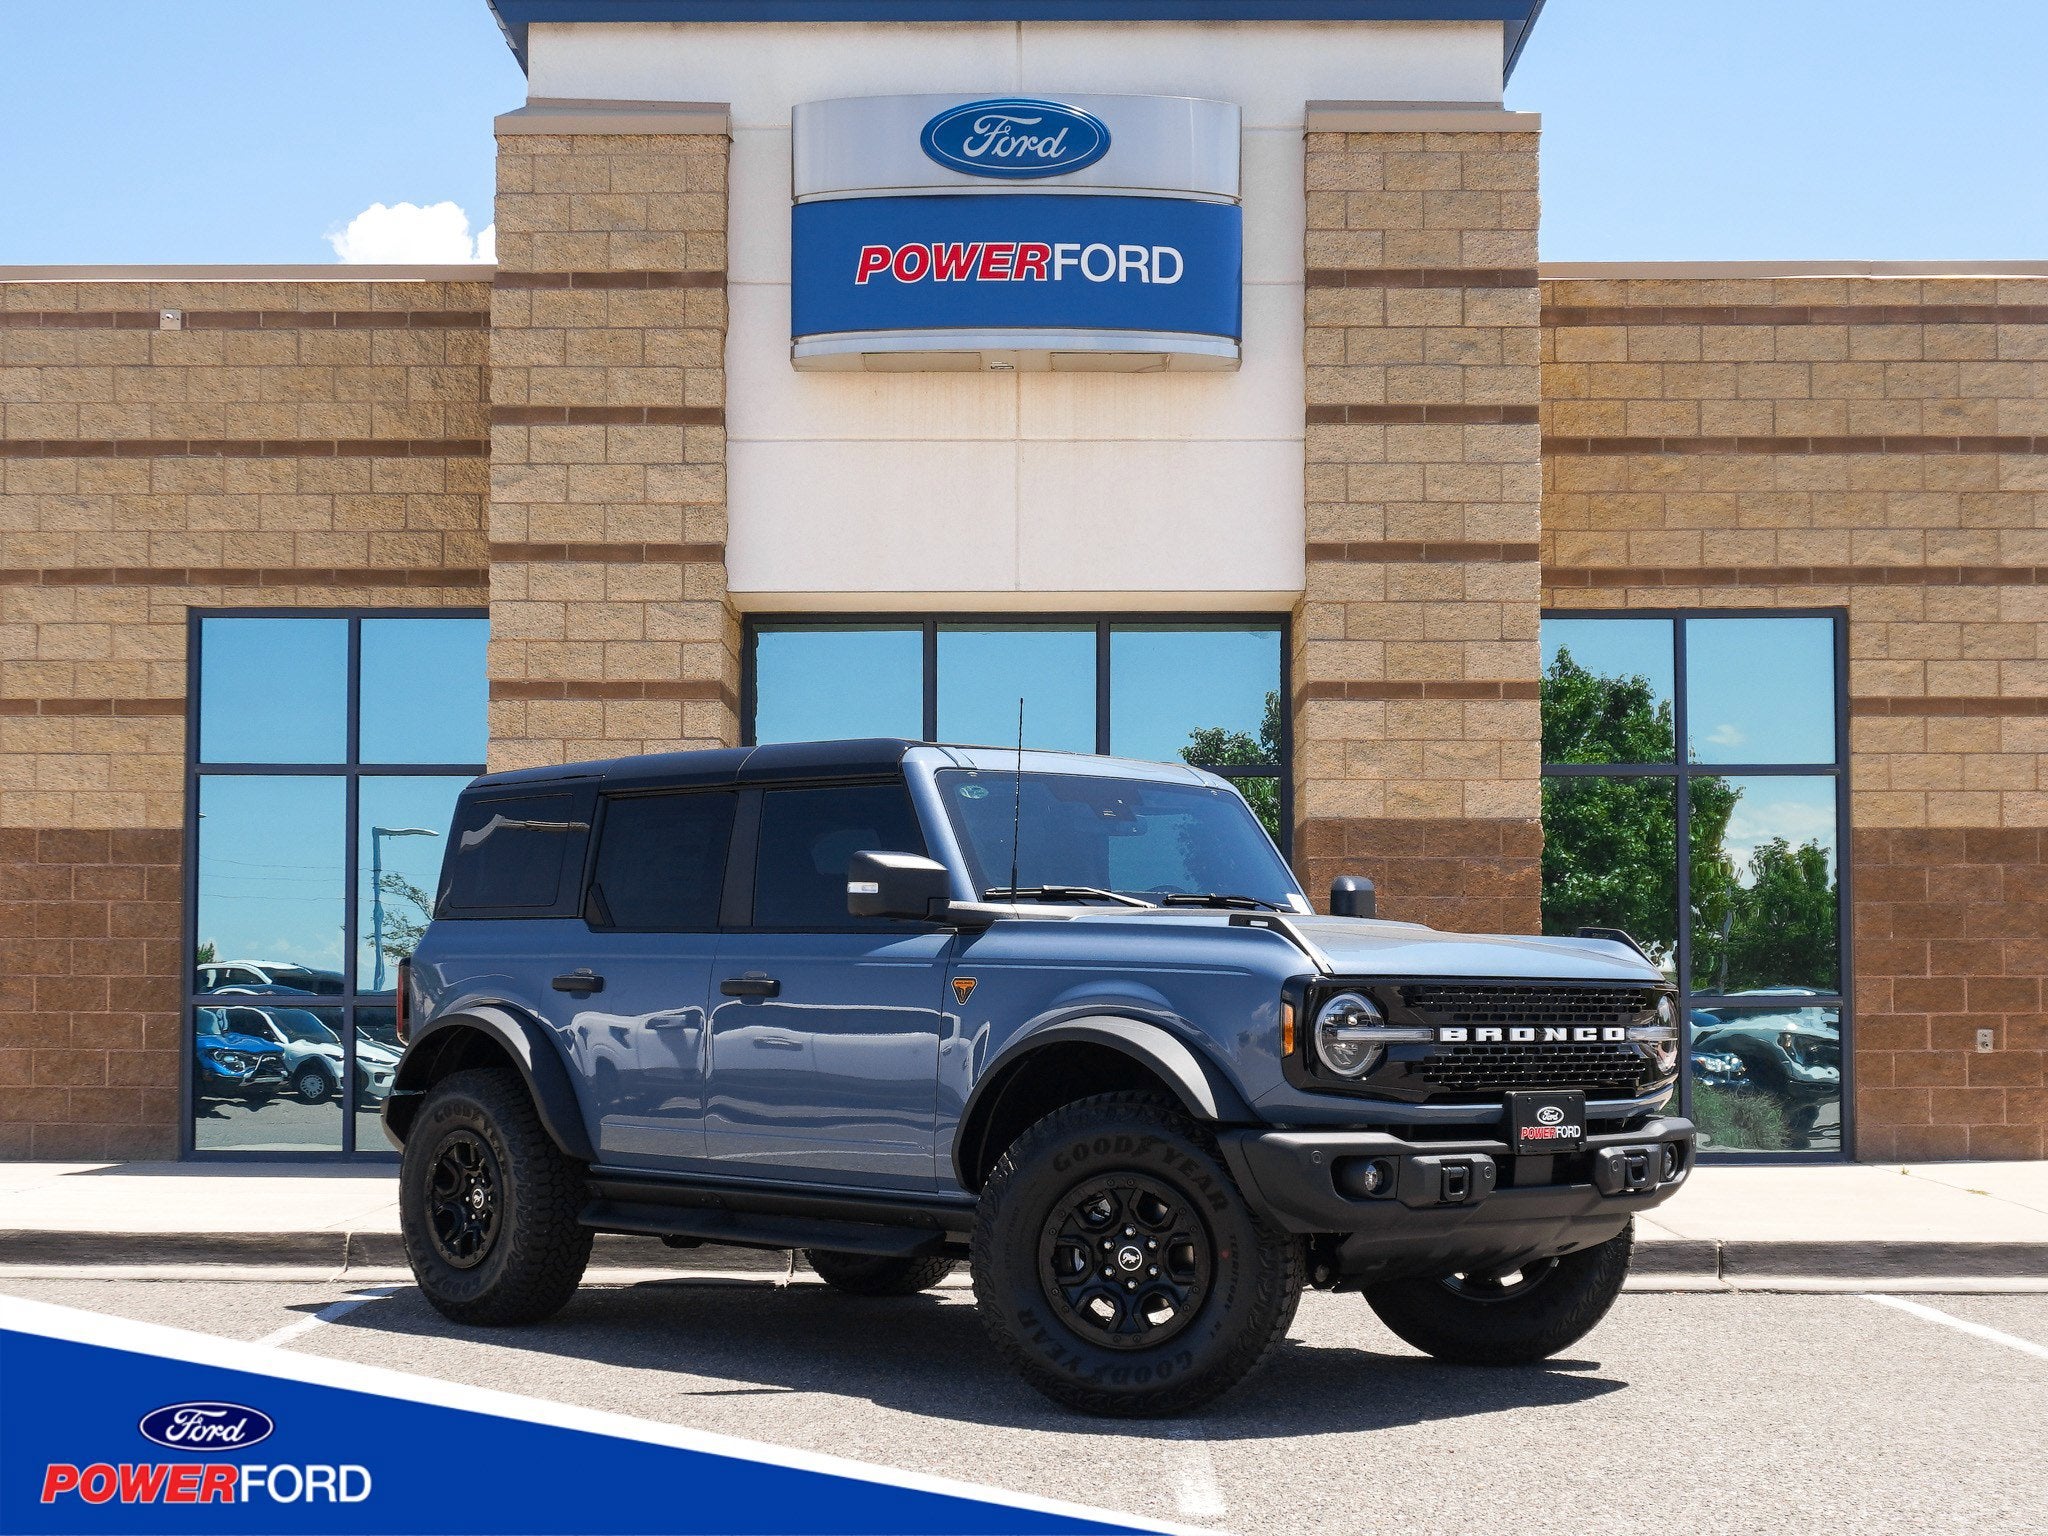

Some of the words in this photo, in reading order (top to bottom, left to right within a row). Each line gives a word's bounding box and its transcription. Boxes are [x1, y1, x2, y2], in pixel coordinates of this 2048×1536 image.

[963, 114, 1069, 159] Ford
[855, 242, 1184, 285] POWERFORD
[1439, 1027, 1625, 1043] BRONCO
[1542, 1109, 1559, 1121] Ford
[1520, 1125, 1581, 1140] POWERFORD
